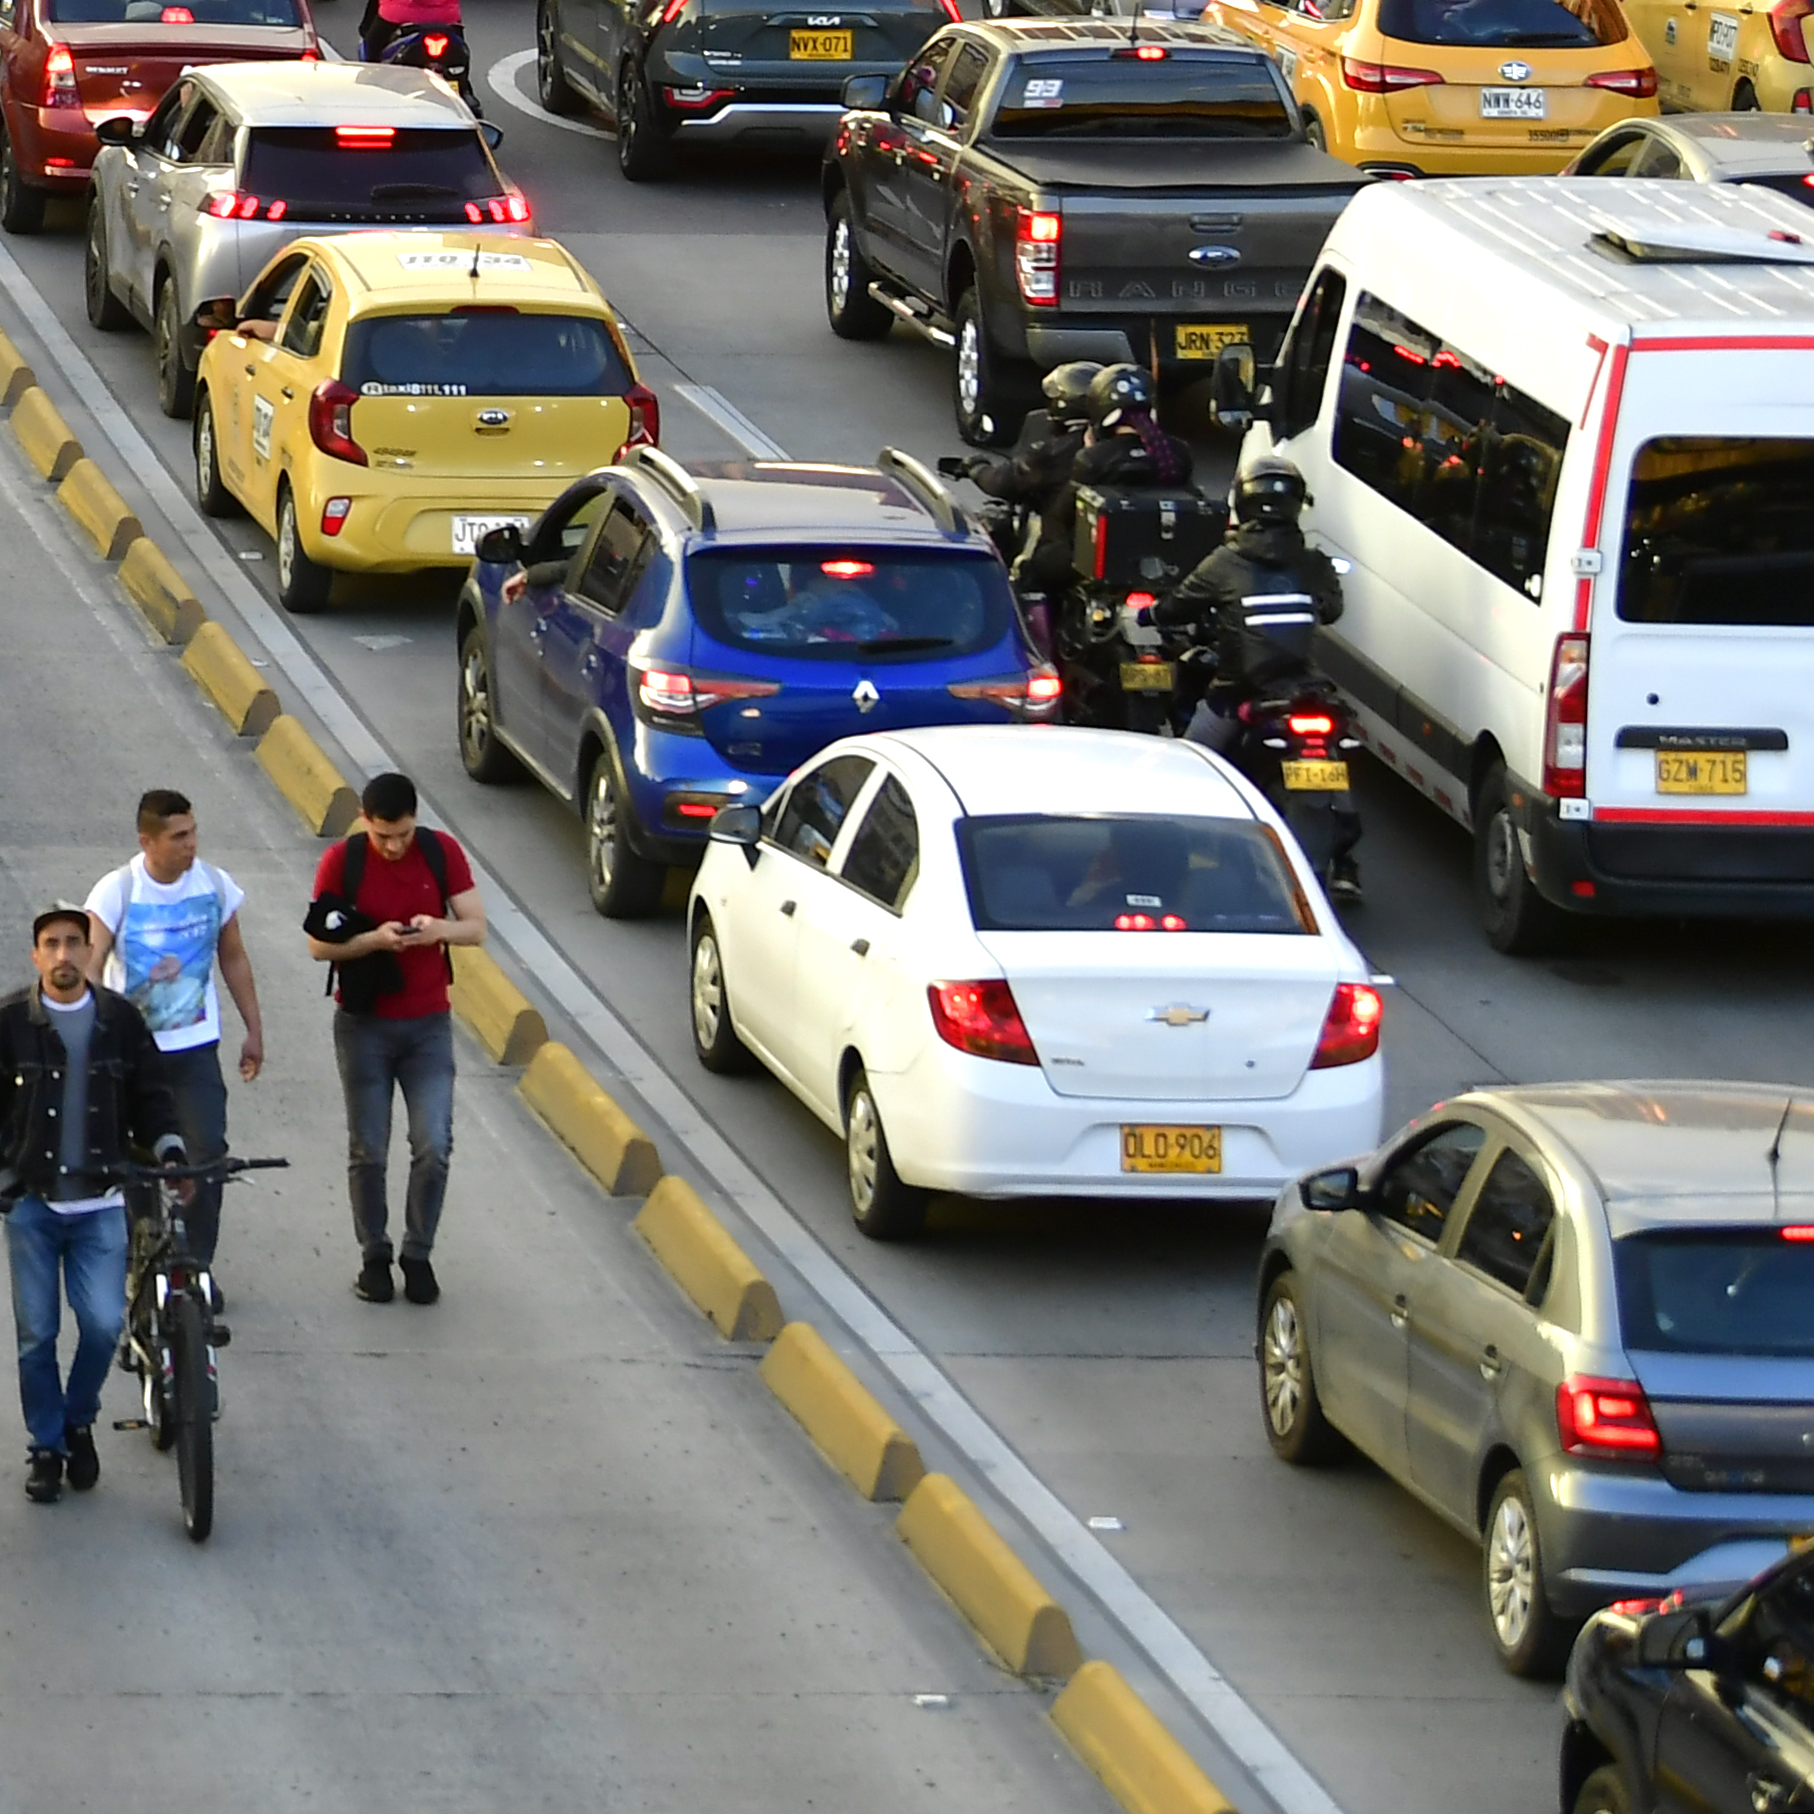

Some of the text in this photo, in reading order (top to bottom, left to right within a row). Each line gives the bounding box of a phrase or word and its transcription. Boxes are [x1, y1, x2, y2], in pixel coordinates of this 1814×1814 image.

[792, 34, 850, 55] NVX-071
[1068, 278, 1301, 299] RANGE
[1661, 735, 1748, 748] MASTER
[1658, 752, 1746, 783] GZW-715
